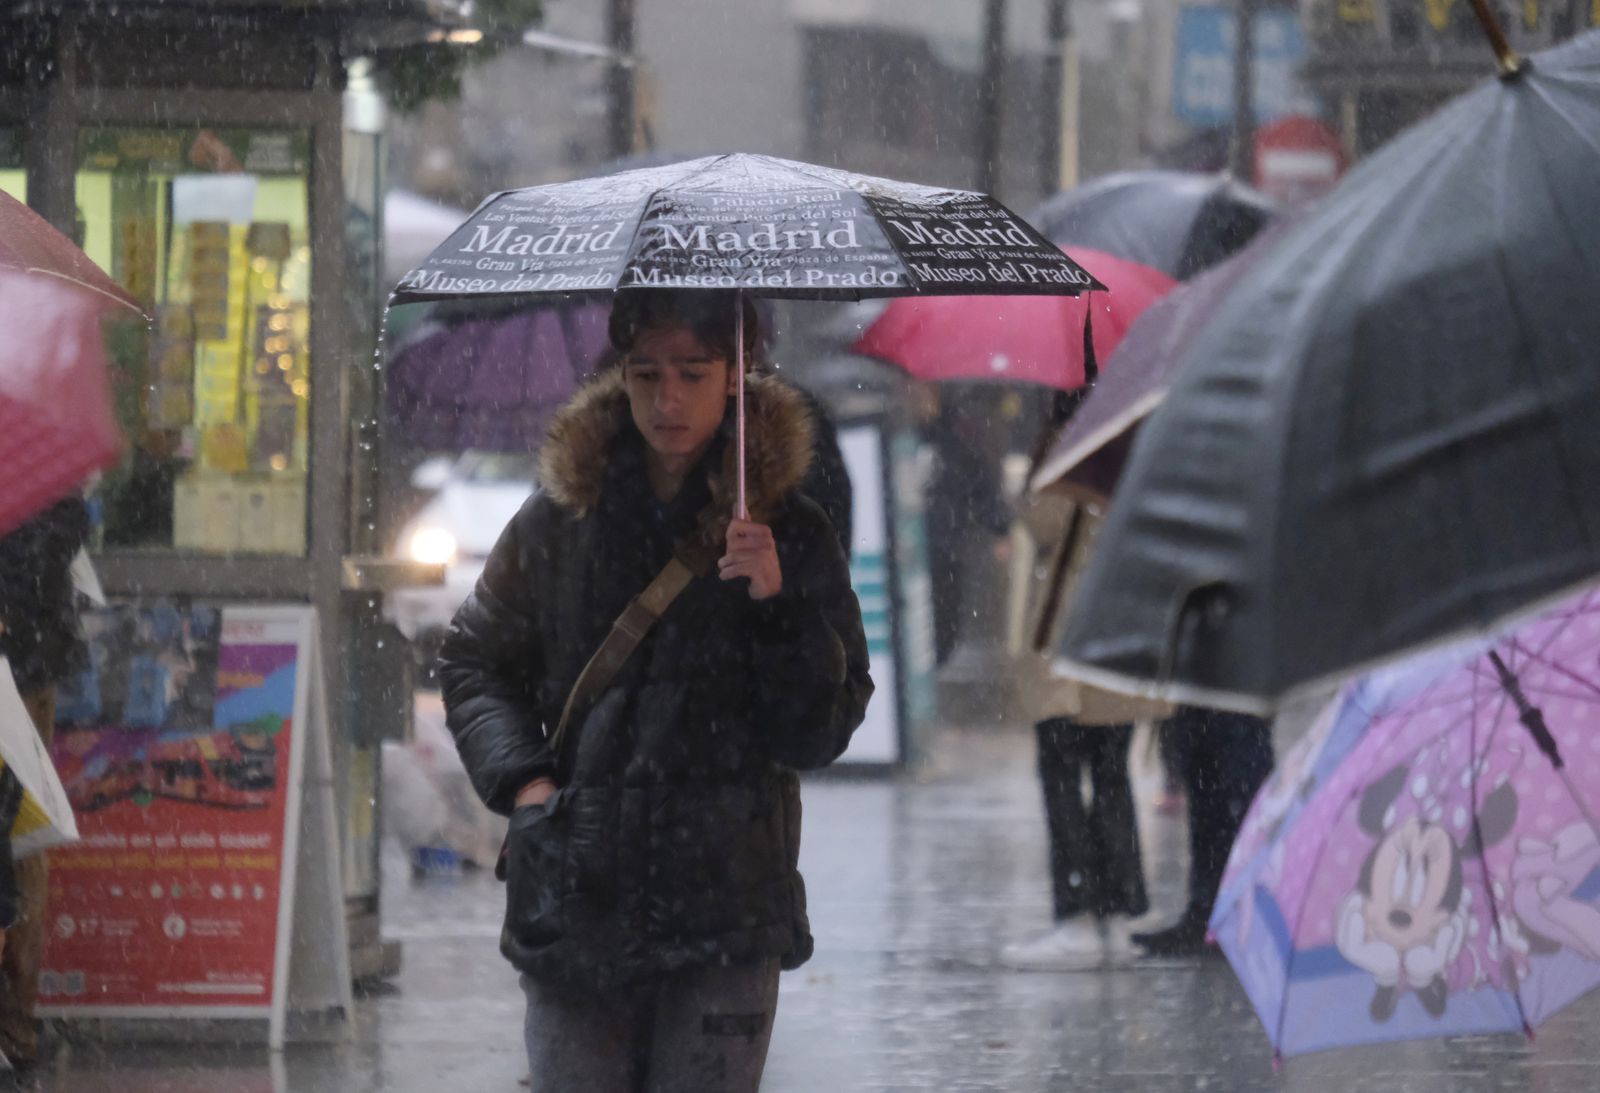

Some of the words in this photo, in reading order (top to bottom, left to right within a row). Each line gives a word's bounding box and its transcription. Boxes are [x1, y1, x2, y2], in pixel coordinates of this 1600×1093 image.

[711, 197, 788, 207] Palacio
[795, 191, 842, 203] Real
[484, 212, 504, 222] Las
[508, 213, 546, 223] Ventas
[686, 213, 737, 222] Ventas
[743, 213, 797, 222] Puerta
[801, 209, 826, 219] del
[831, 208, 857, 218] Sol
[969, 209, 990, 219] del
[988, 208, 1010, 219] Sol
[458, 221, 624, 255] Madrid
[656, 219, 862, 252] Madrid
[886, 219, 1039, 247] Madrid
[691, 254, 741, 267] Gran
[788, 255, 820, 264] Plaza
[825, 255, 839, 263] de
[936, 247, 975, 260] Gran
[475, 257, 515, 271] Gran
[406, 269, 498, 292] Museo
[500, 273, 545, 292] del
[543, 267, 613, 290] Prado
[628, 266, 737, 287] Museo
[745, 269, 795, 287] del
[804, 265, 898, 287] Prado
[908, 262, 987, 282] Museo
[986, 261, 1025, 282] del
[1019, 263, 1092, 285] Prado
